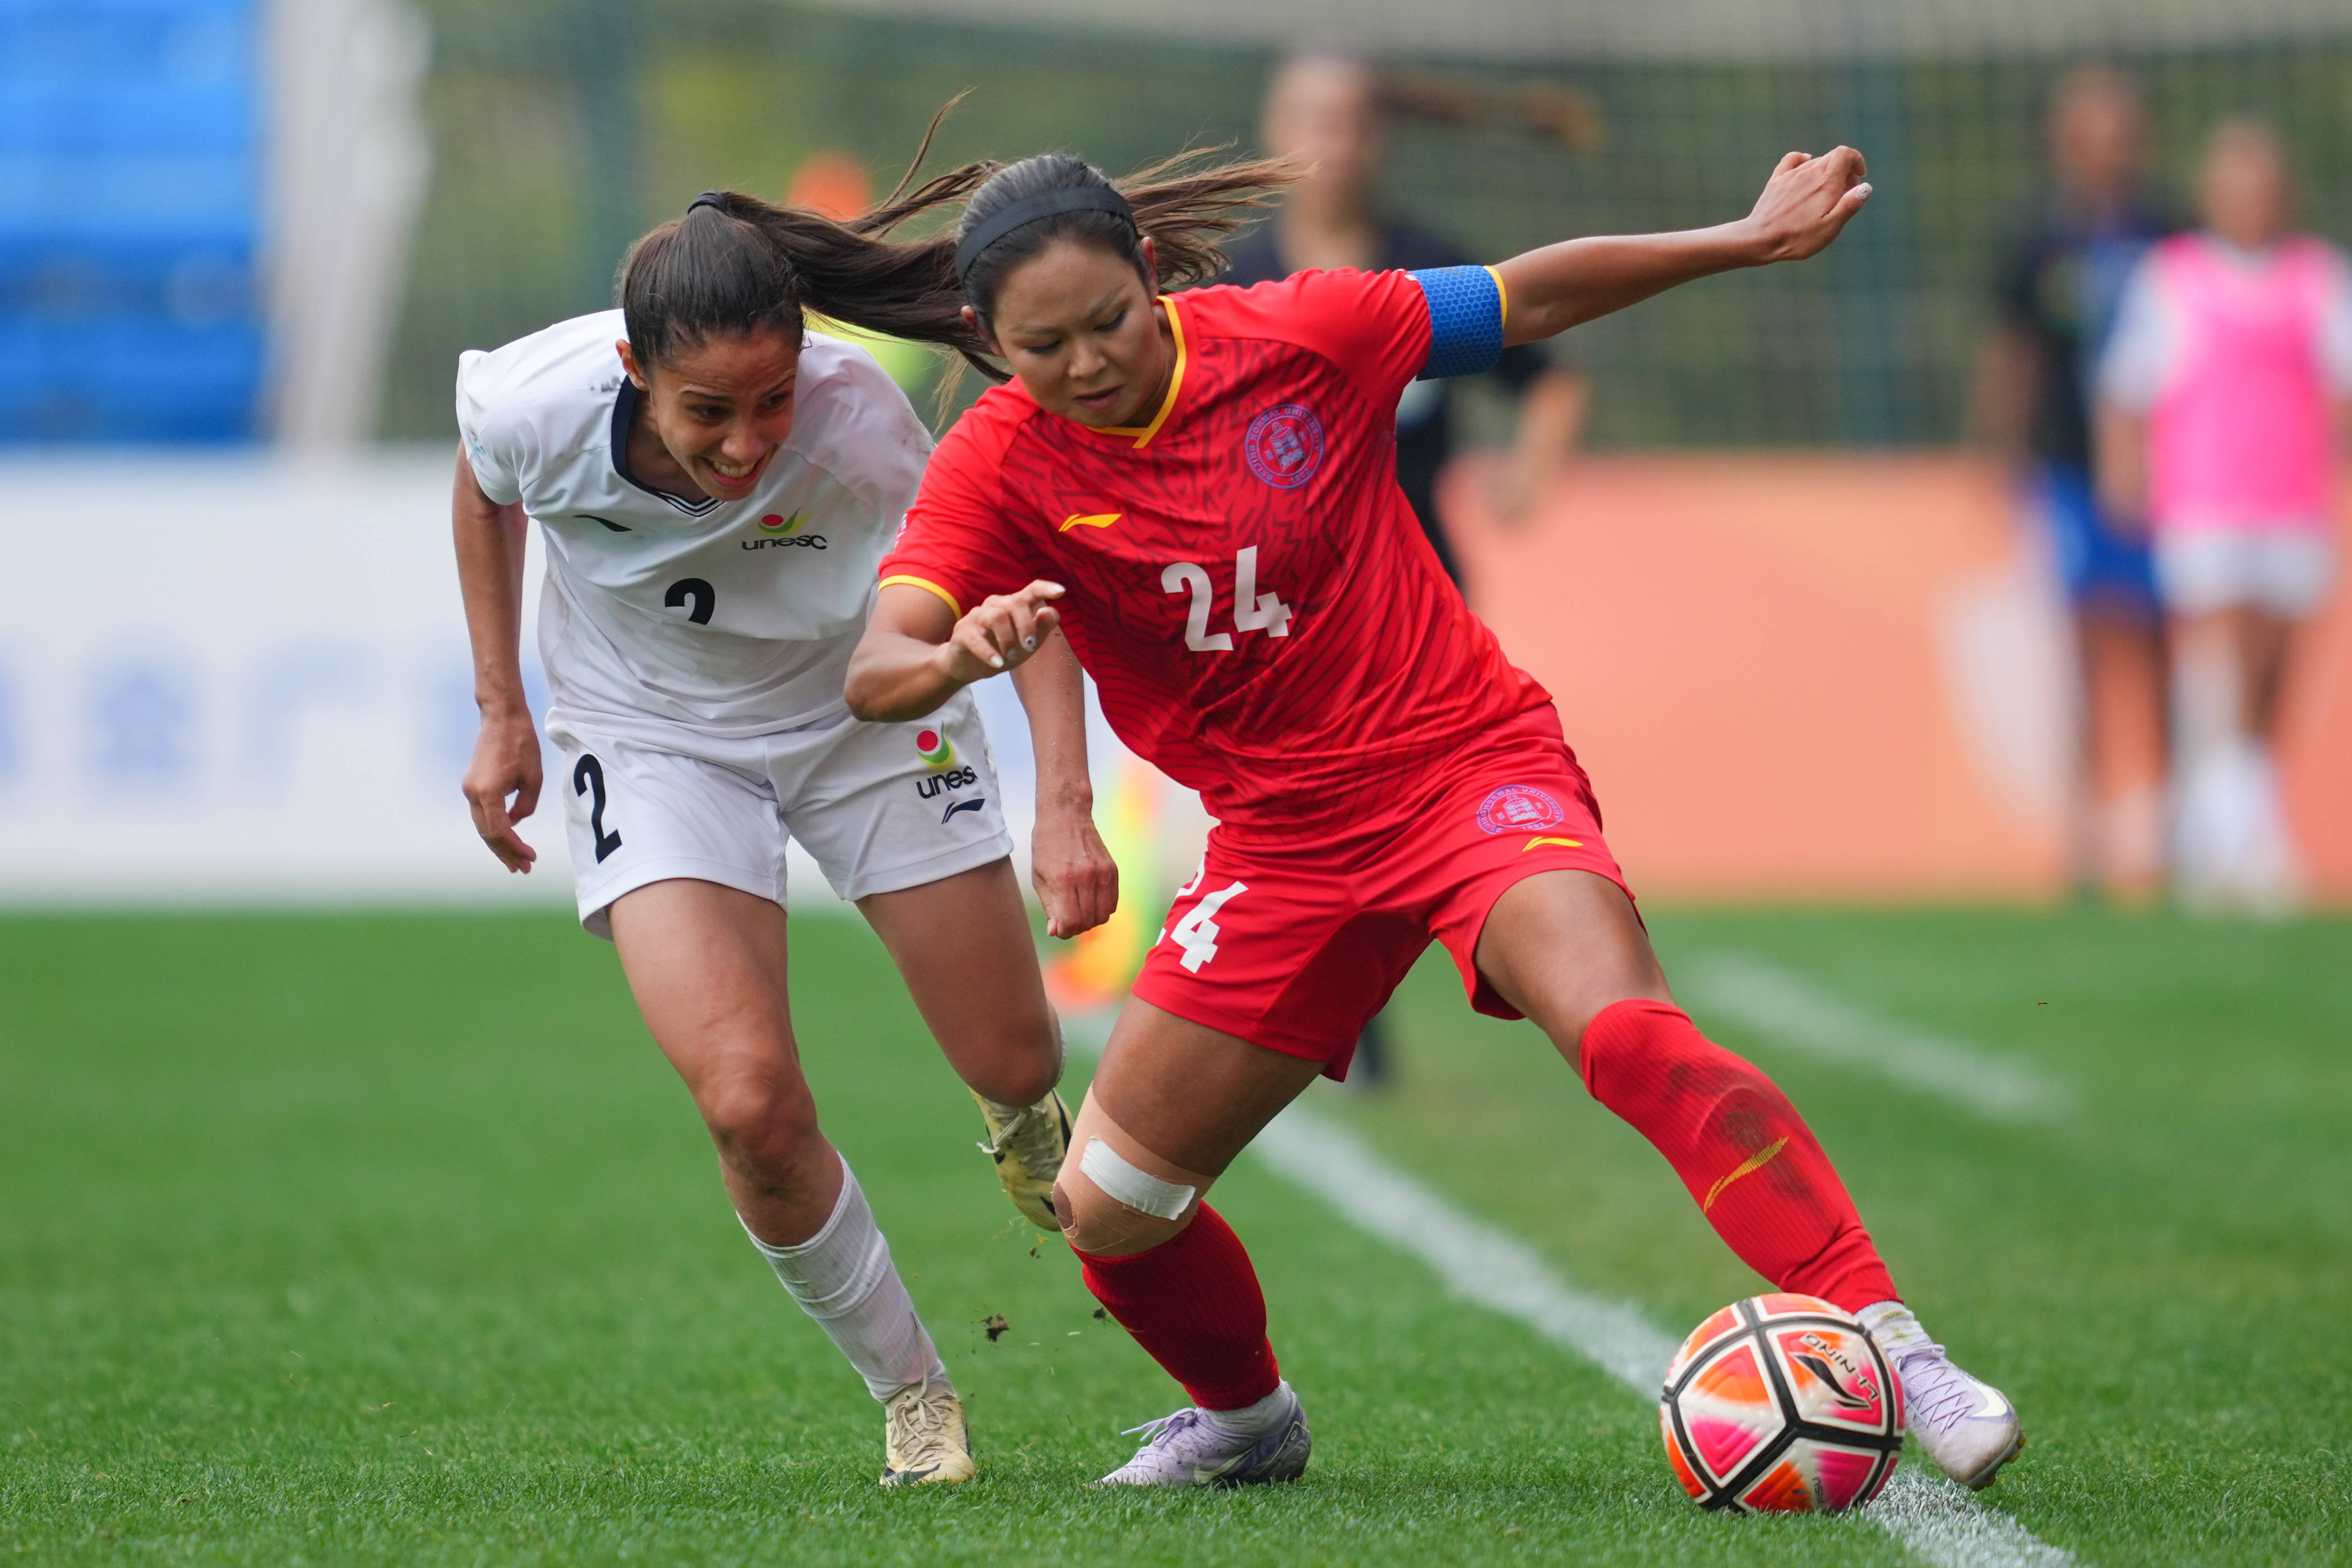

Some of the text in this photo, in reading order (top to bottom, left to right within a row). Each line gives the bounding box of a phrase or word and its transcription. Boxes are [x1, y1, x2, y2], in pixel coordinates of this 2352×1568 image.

[1250, 410, 1281, 441] NORMAL
[741, 535, 828, 551] unesc
[1161, 544, 1293, 651] 24
[916, 765, 978, 799] unes
[1484, 788, 1518, 809] NORMAL
[574, 753, 622, 864] 2
[1805, 1333, 1879, 1400] LI-NING
